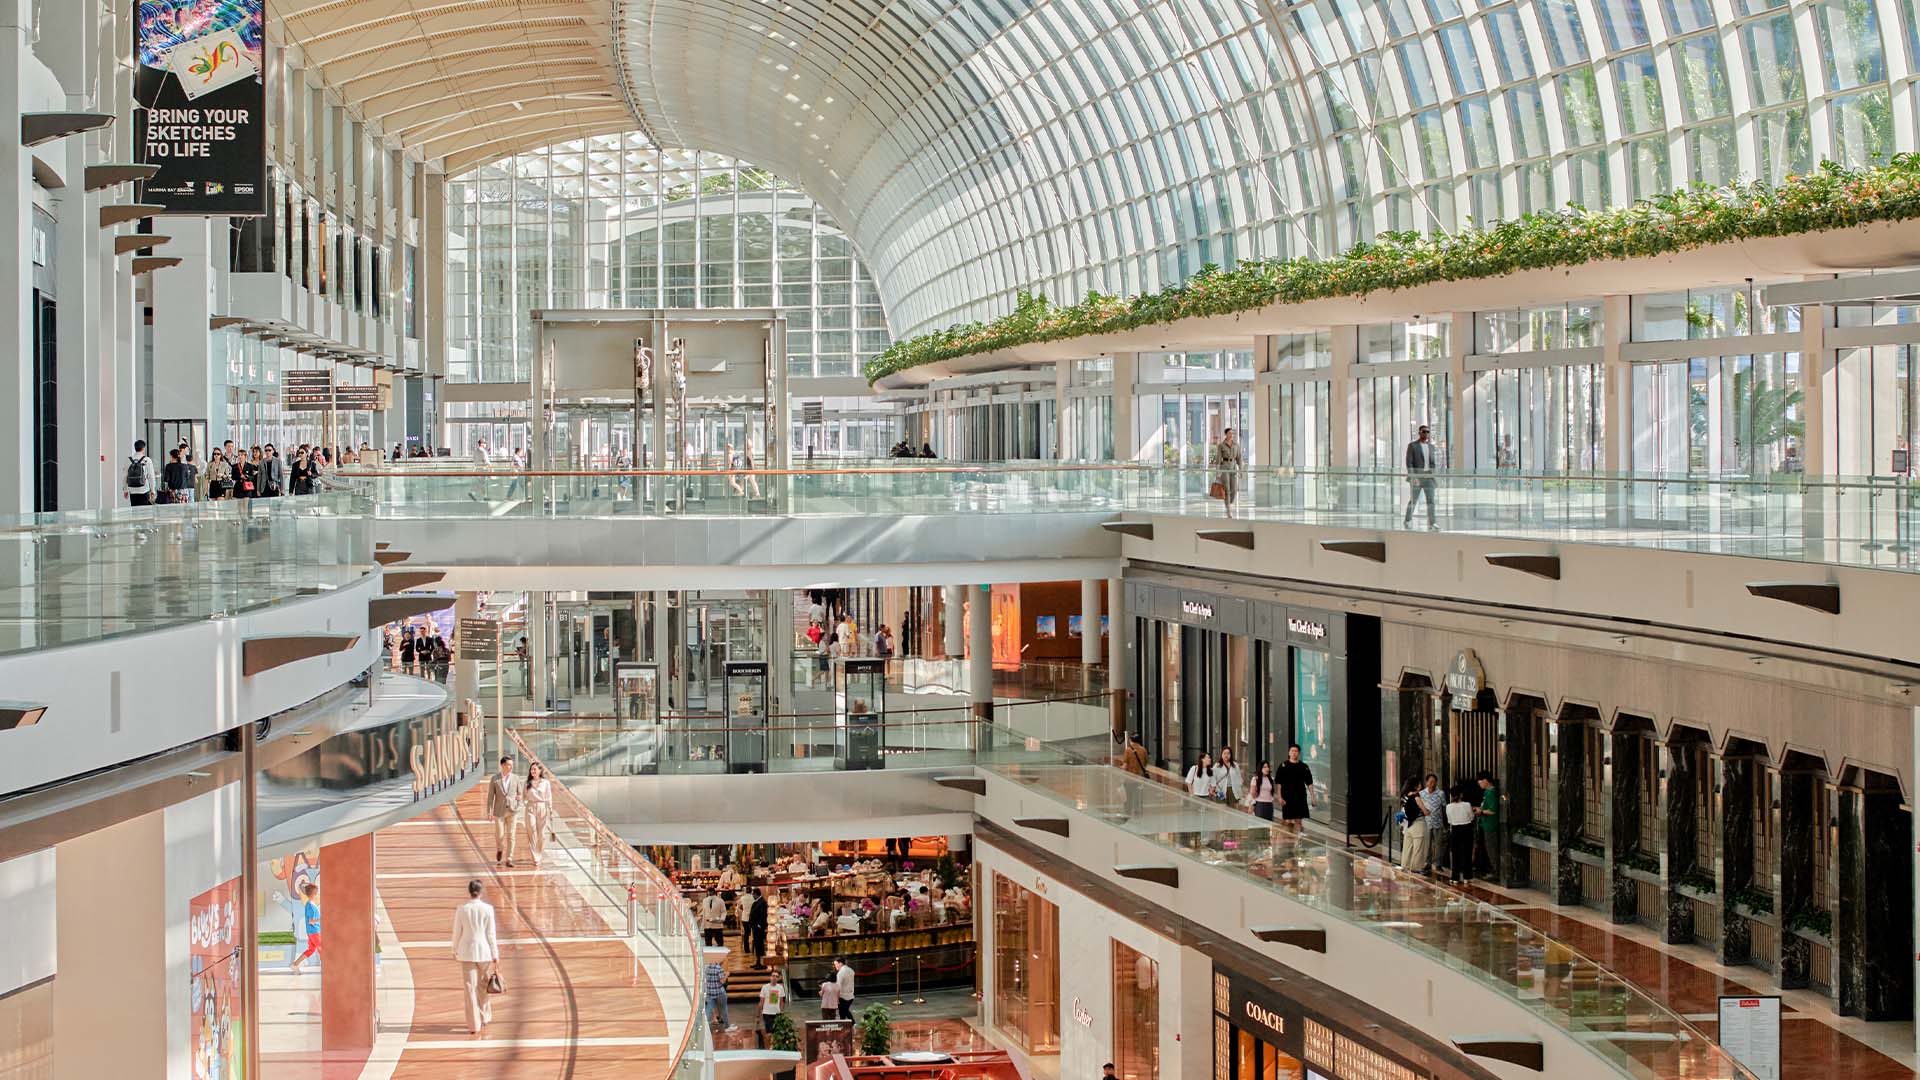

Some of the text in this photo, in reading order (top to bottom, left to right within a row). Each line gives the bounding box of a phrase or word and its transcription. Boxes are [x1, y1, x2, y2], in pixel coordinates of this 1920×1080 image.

[148, 109, 249, 124] BRING YOUR
[147, 126, 236, 140] SKETCHES
[147, 142, 211, 157] TO LIFE
[1288, 618, 1296, 632] Van
[410, 726, 468, 793] SANDS
[1073, 997, 1093, 1028] Cartier
[1246, 1000, 1284, 1034] COACH
